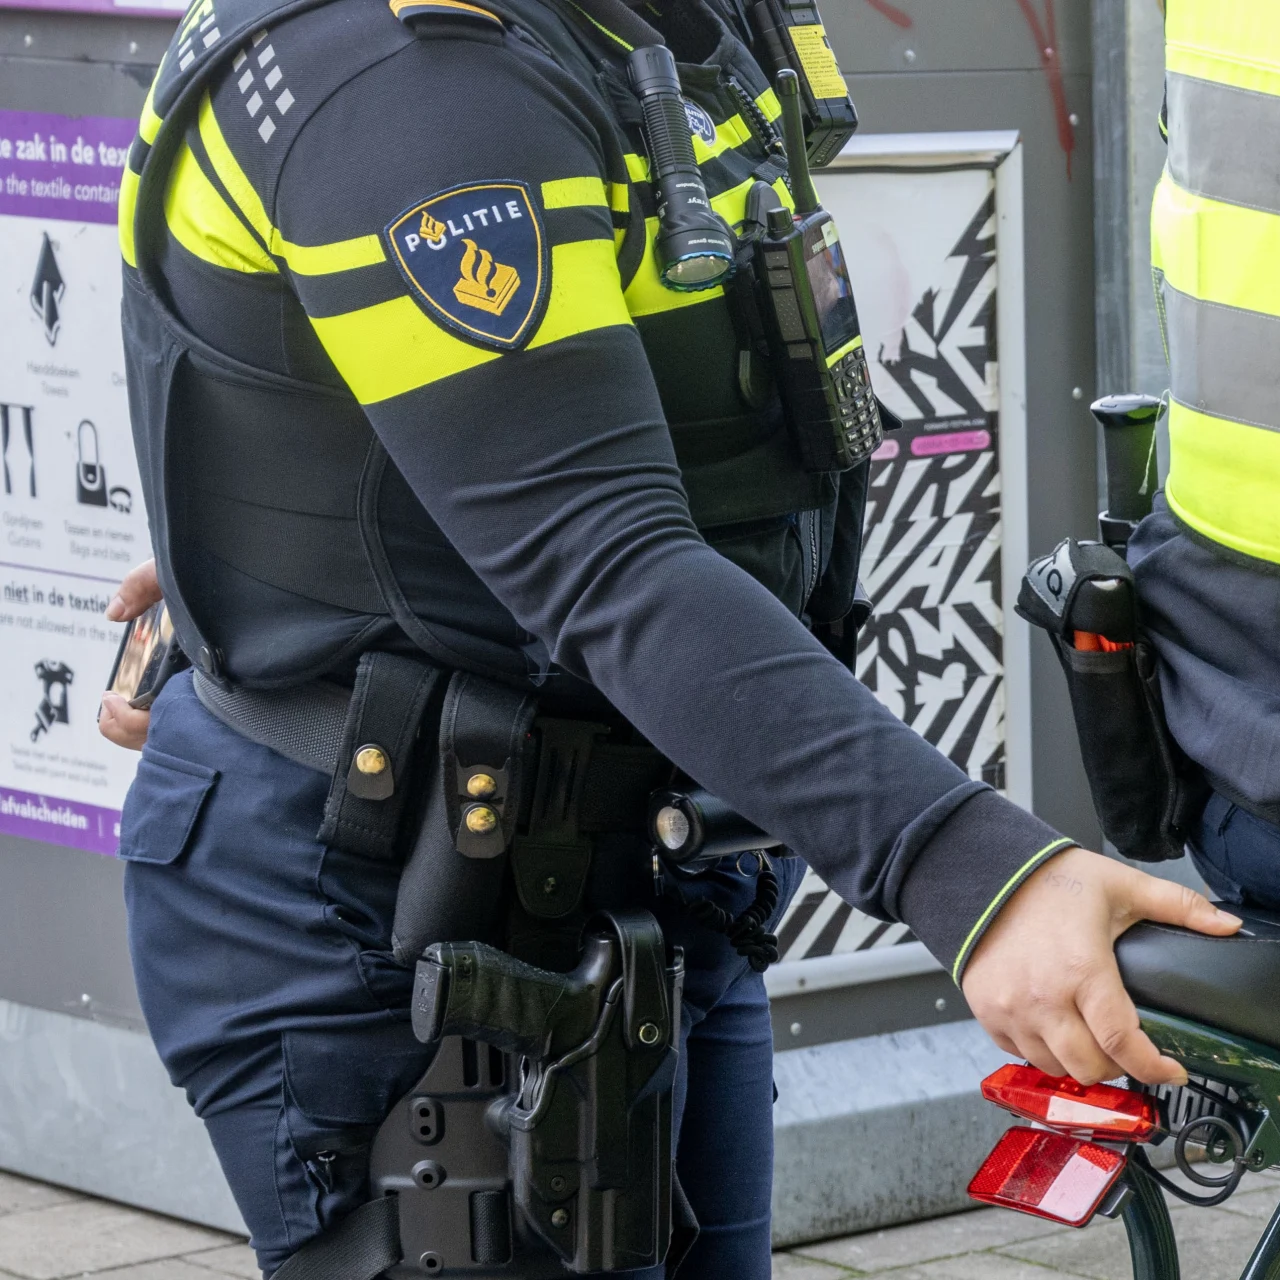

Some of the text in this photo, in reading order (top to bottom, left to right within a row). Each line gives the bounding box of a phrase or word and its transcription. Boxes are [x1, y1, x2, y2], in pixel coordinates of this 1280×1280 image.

[16, 132, 47, 162] zak
[49, 134, 67, 163] in
[71, 135, 95, 166] de
[6, 172, 28, 196] the
[31, 176, 71, 200] textile
[404, 200, 522, 253] POLITIE
[4, 581, 29, 602] niet
[32, 584, 45, 604] in
[48, 587, 65, 608] de
[16, 614, 33, 630] not
[35, 617, 75, 637] allowed
[78, 622, 87, 638] in
[89, 624, 106, 641] the
[0, 793, 89, 830] afvalscheiden
